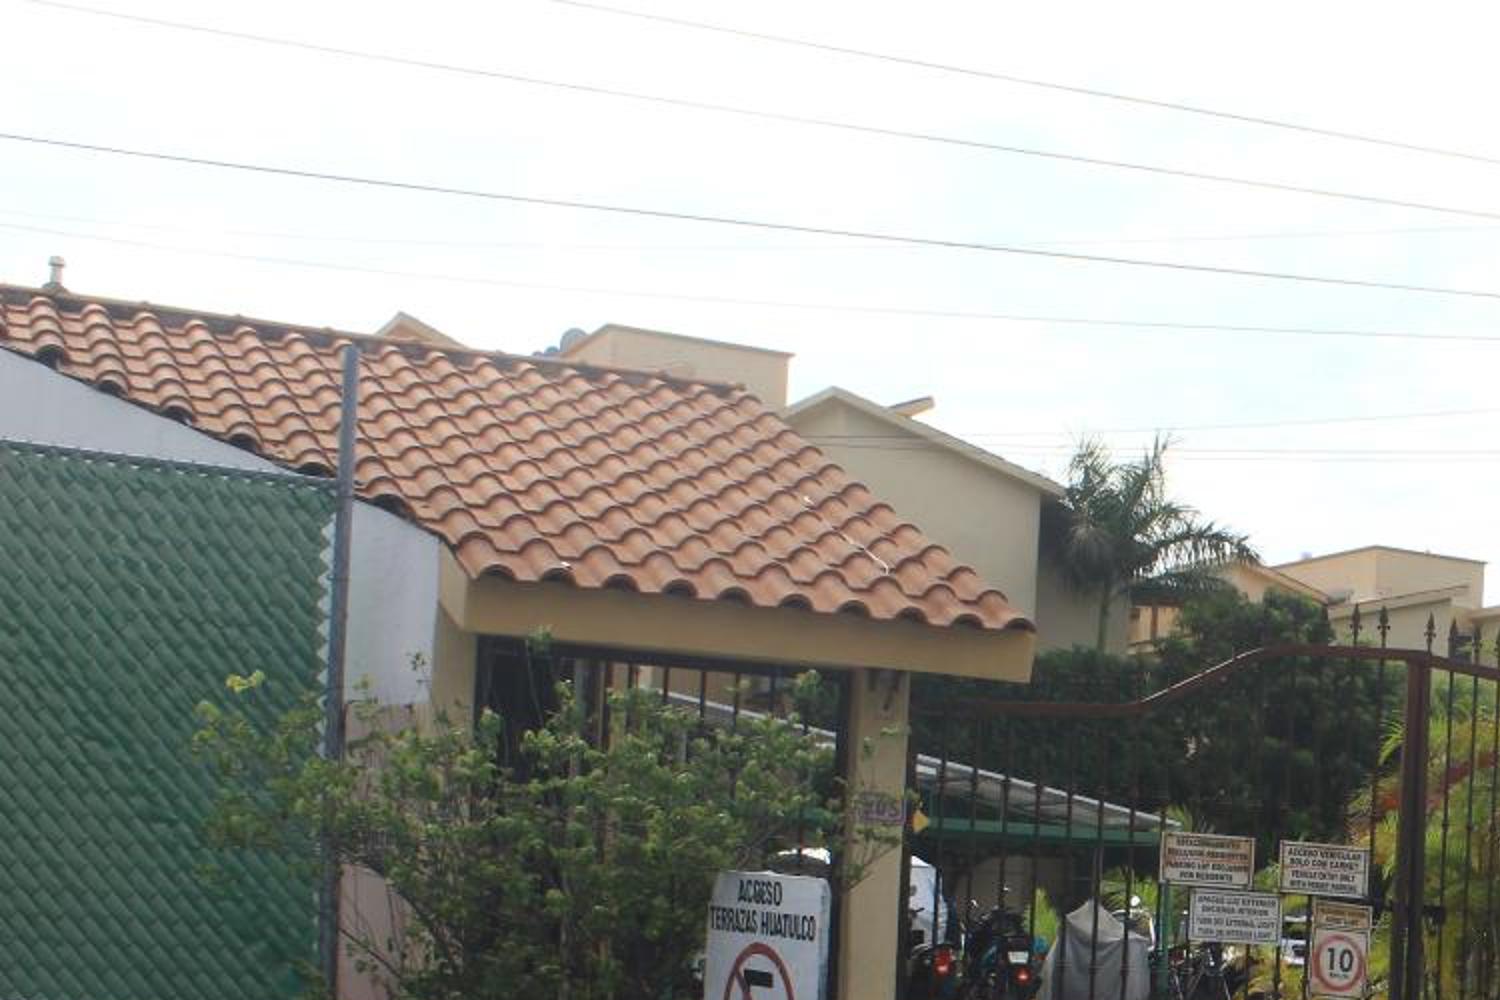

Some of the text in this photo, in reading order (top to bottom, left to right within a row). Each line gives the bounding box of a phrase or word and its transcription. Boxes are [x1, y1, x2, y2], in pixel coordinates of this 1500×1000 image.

[737, 879, 783, 906] ACCESO
[710, 905, 817, 941] TERRAZAS HUATULCO
[1327, 947, 1354, 972] 10
